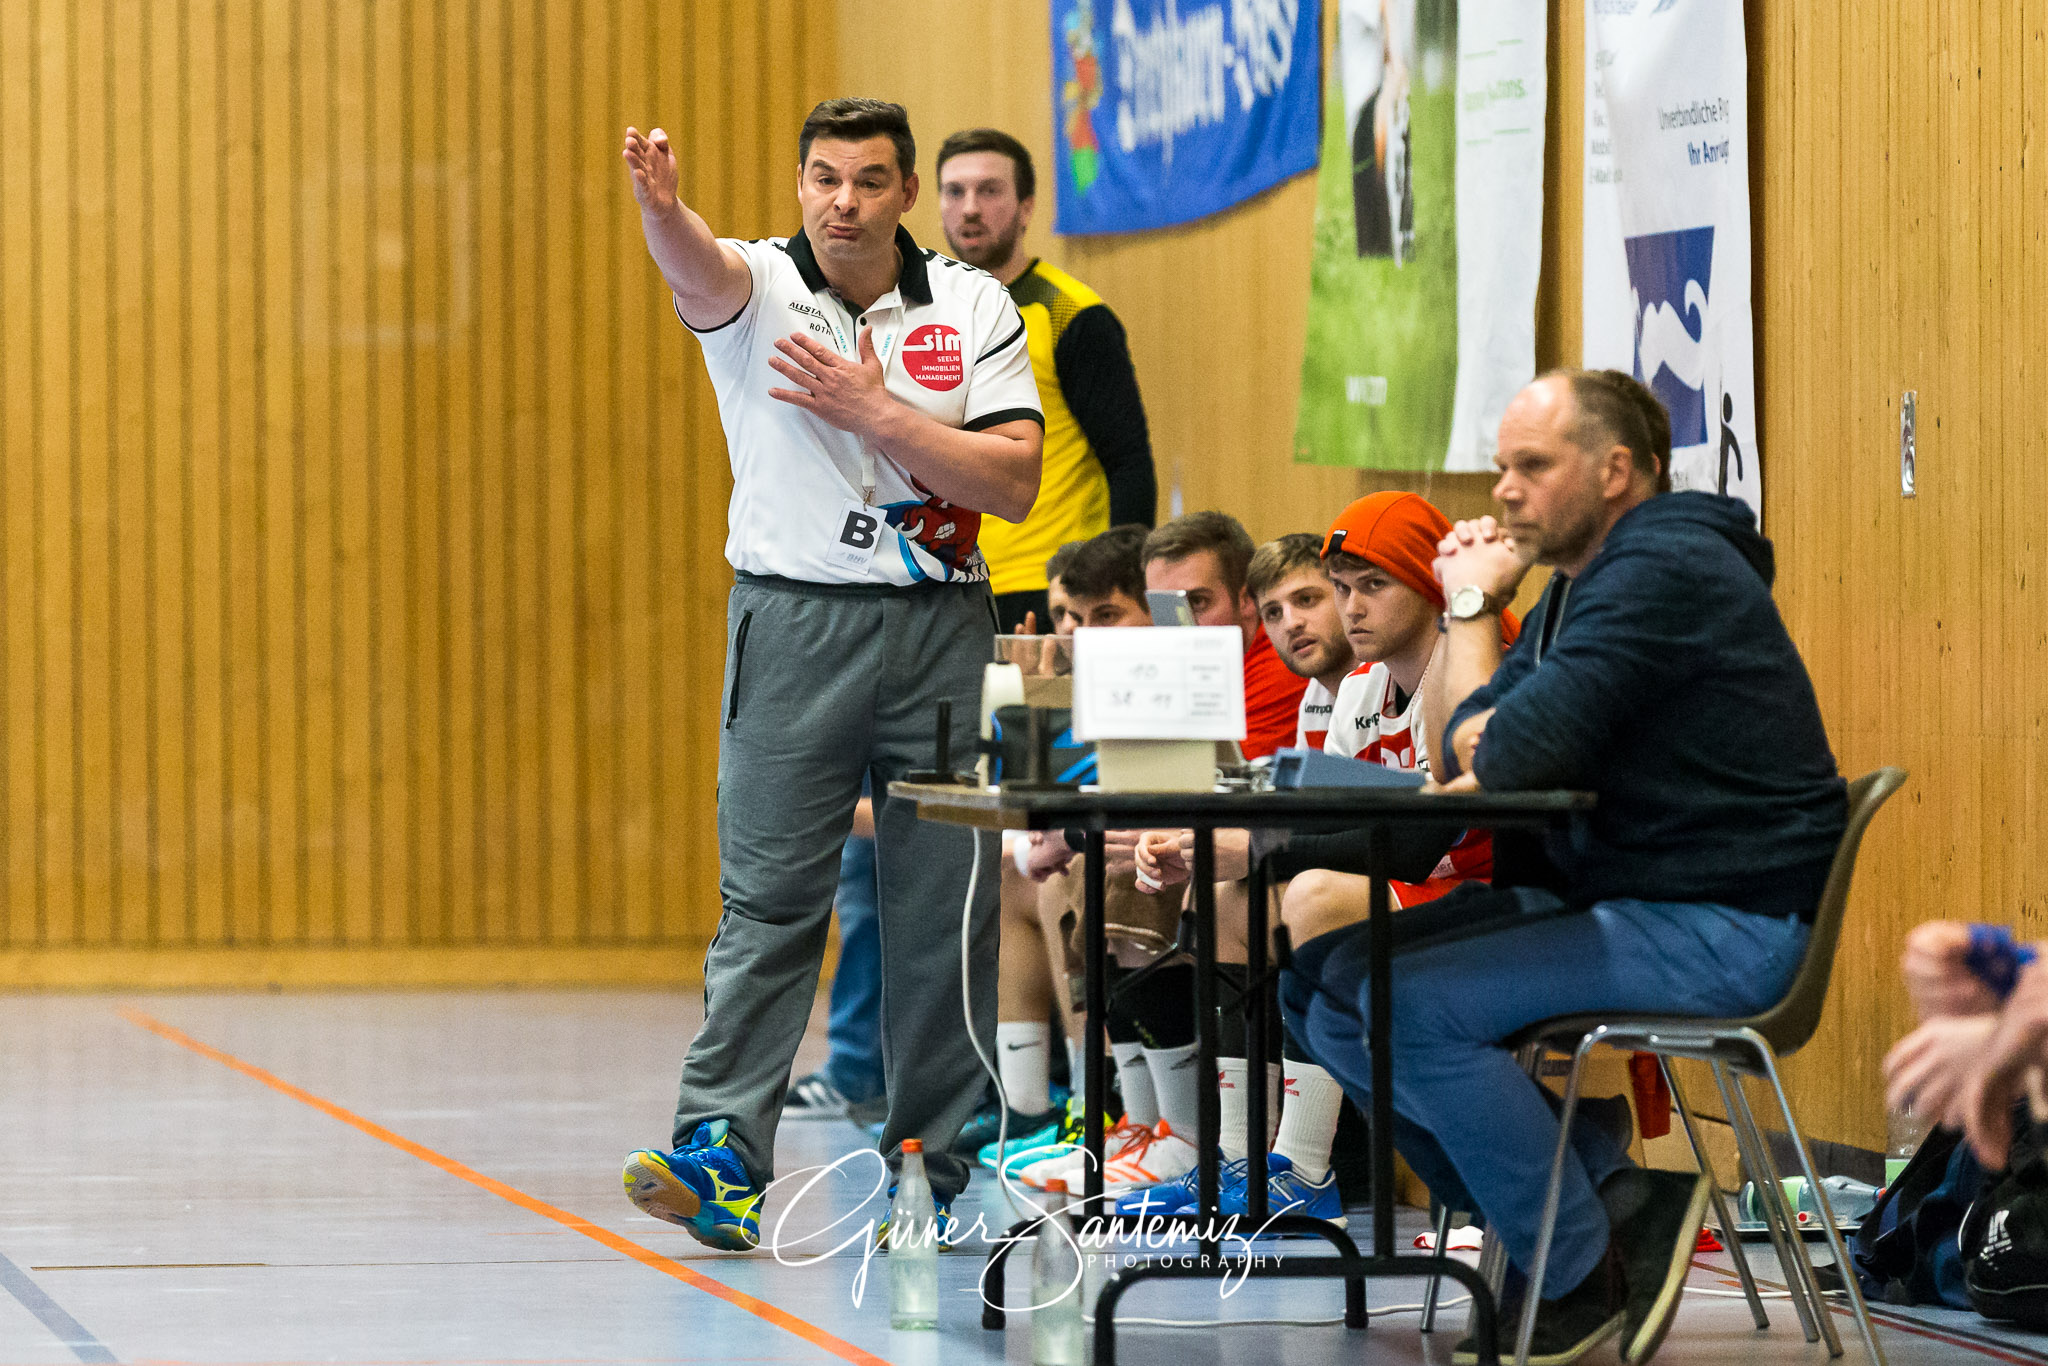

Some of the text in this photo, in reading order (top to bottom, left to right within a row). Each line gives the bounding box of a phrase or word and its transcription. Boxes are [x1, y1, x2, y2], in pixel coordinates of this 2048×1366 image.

[788, 301, 825, 319] ALLSTA
[921, 364, 961, 372] IMMOBILIEN
[915, 373, 961, 381] MANAGEMENT
[839, 510, 878, 550] B
